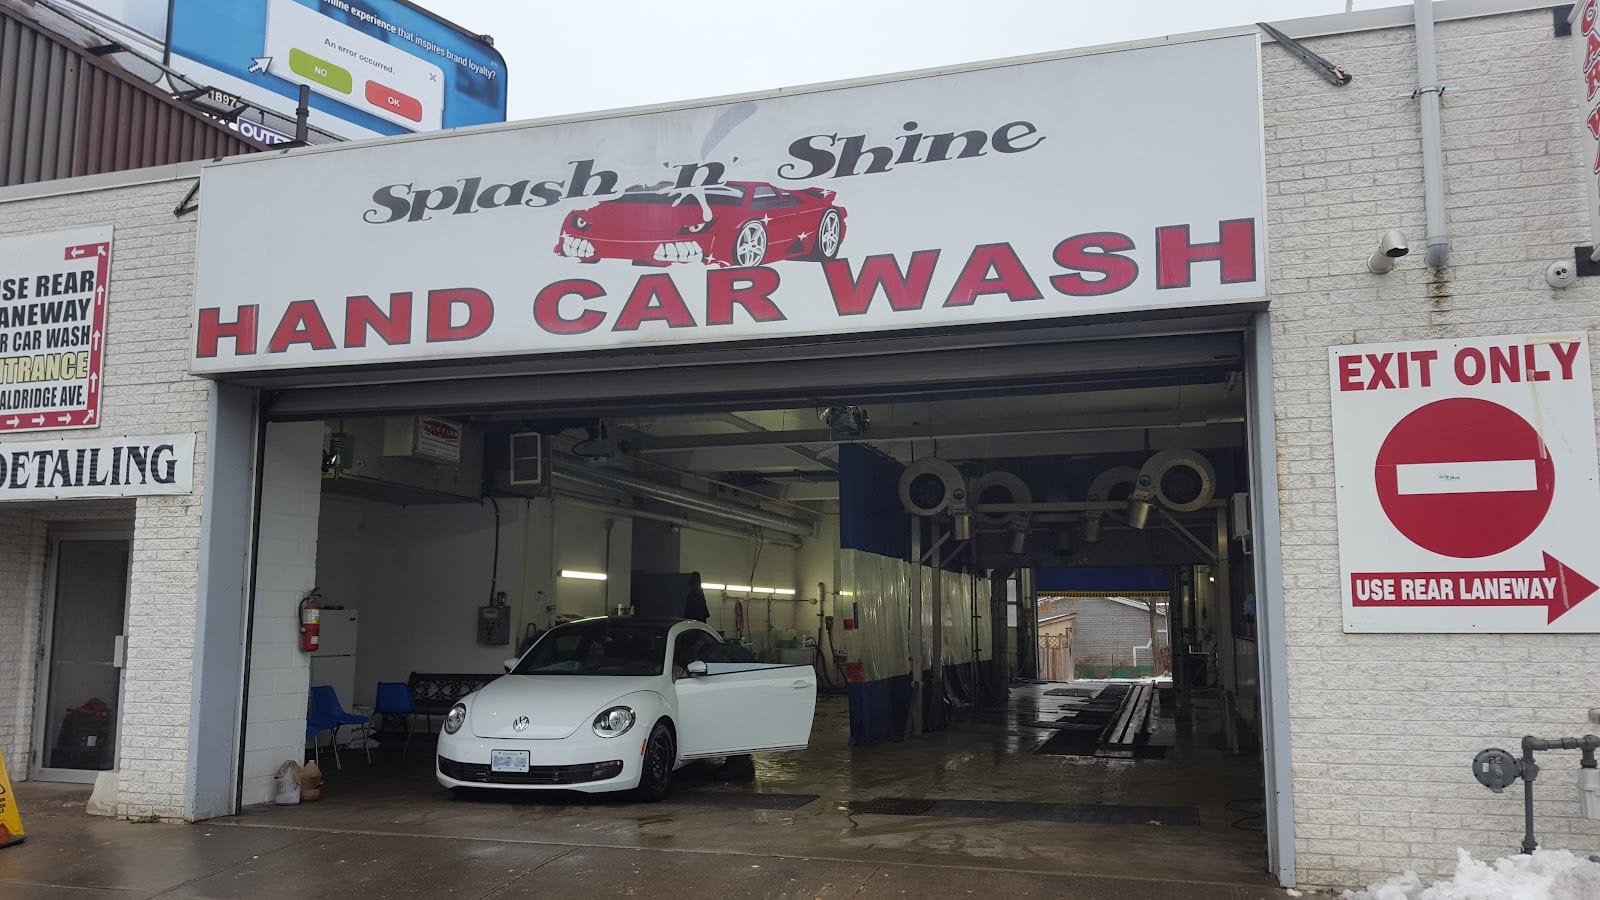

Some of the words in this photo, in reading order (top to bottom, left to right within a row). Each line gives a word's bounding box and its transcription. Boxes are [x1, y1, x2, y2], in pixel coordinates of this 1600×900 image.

[324, 38, 337, 49] An
[338, 45, 358, 58] error
[359, 54, 396, 75] occurred.
[350, 6, 397, 34] experience
[398, 27, 414, 42] that
[415, 33, 446, 57] inspires
[446, 49, 468, 66] brand
[468, 59, 496, 80] loyalty?
[314, 65, 328, 78] NO
[209, 90, 237, 109] 1897
[387, 96, 401, 108] OK
[362, 158, 619, 225] Splash
[777, 120, 1047, 181] Shine
[0, 277, 29, 301] SE
[35, 270, 95, 298] REAR
[197, 288, 495, 359] HAND
[532, 266, 788, 335] CAR
[823, 218, 1256, 317] WASH
[12, 330, 42, 352] CAR
[46, 325, 91, 348] WASH
[1338, 350, 1438, 391] EXIT
[1453, 341, 1582, 386] ONLY
[59, 384, 85, 406] AVE.
[1356, 579, 1395, 601] USE
[1401, 578, 1454, 600] REAR
[1459, 577, 1557, 600] LANEWAY
